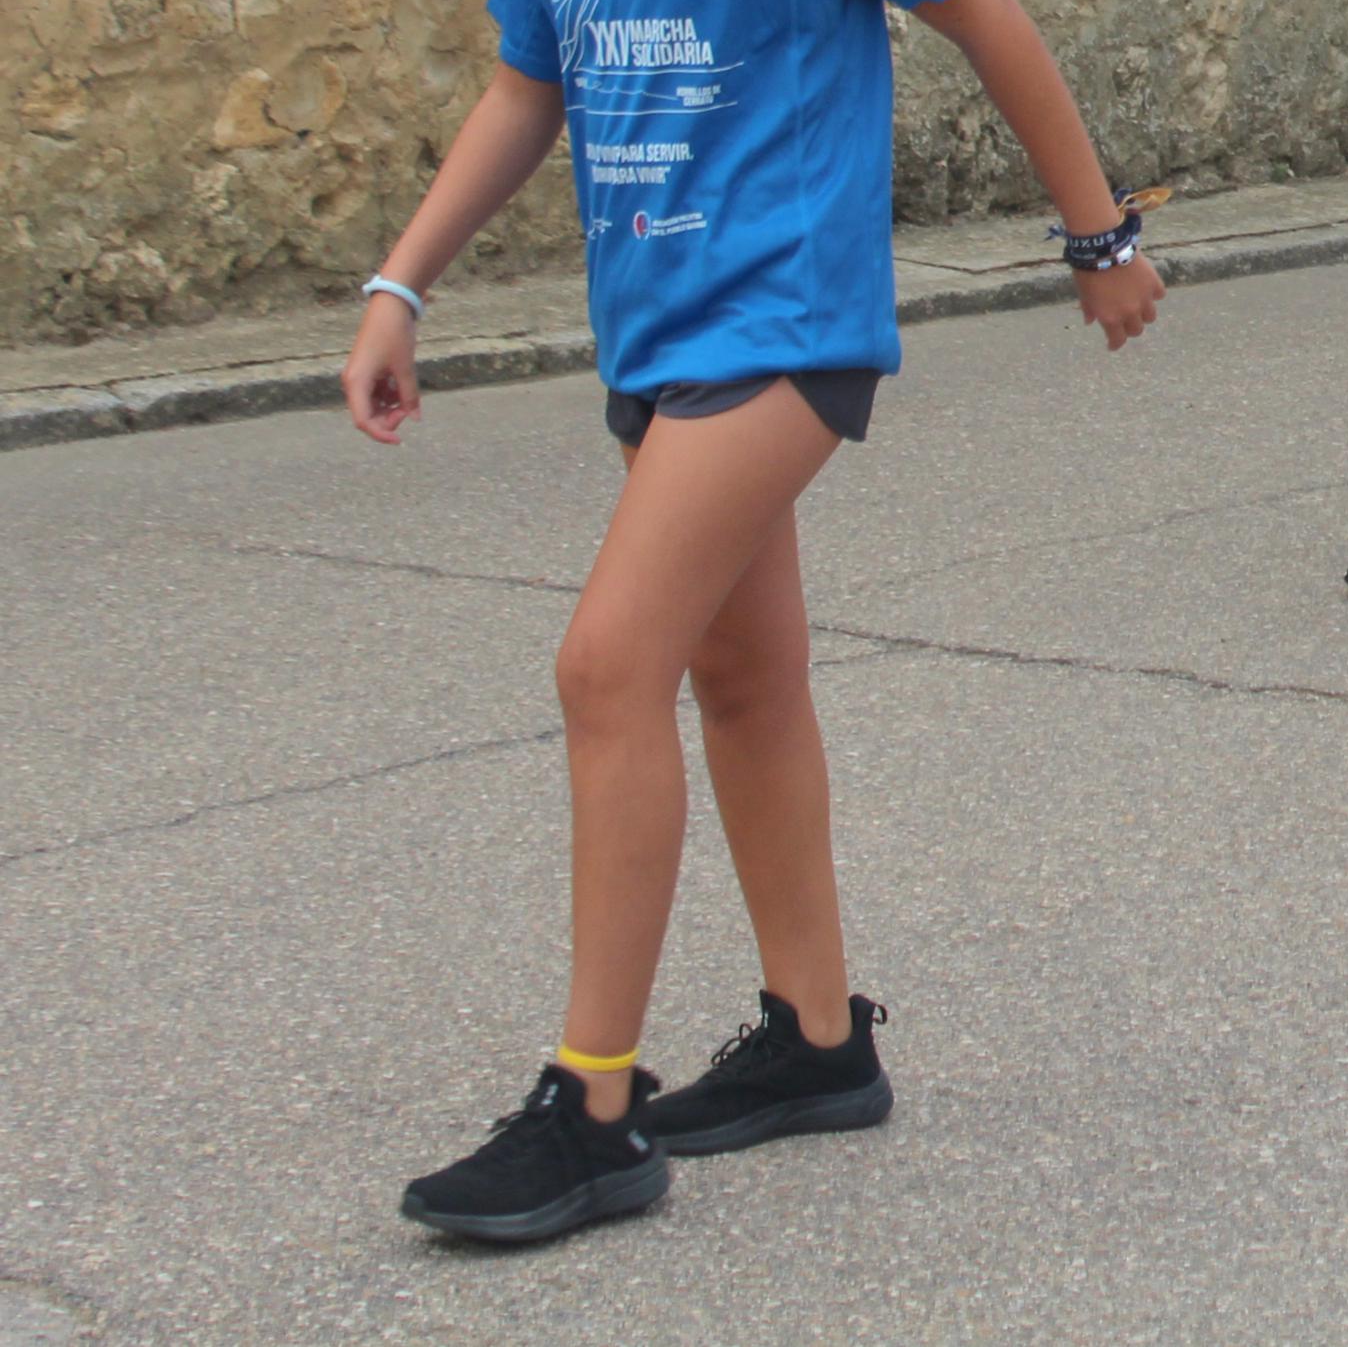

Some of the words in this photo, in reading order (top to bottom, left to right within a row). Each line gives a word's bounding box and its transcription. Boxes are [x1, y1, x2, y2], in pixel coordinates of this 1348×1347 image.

[588, 19, 630, 67] XXV
[630, 18, 697, 43] MARCHA
[631, 40, 715, 67] SOLIDARIA
